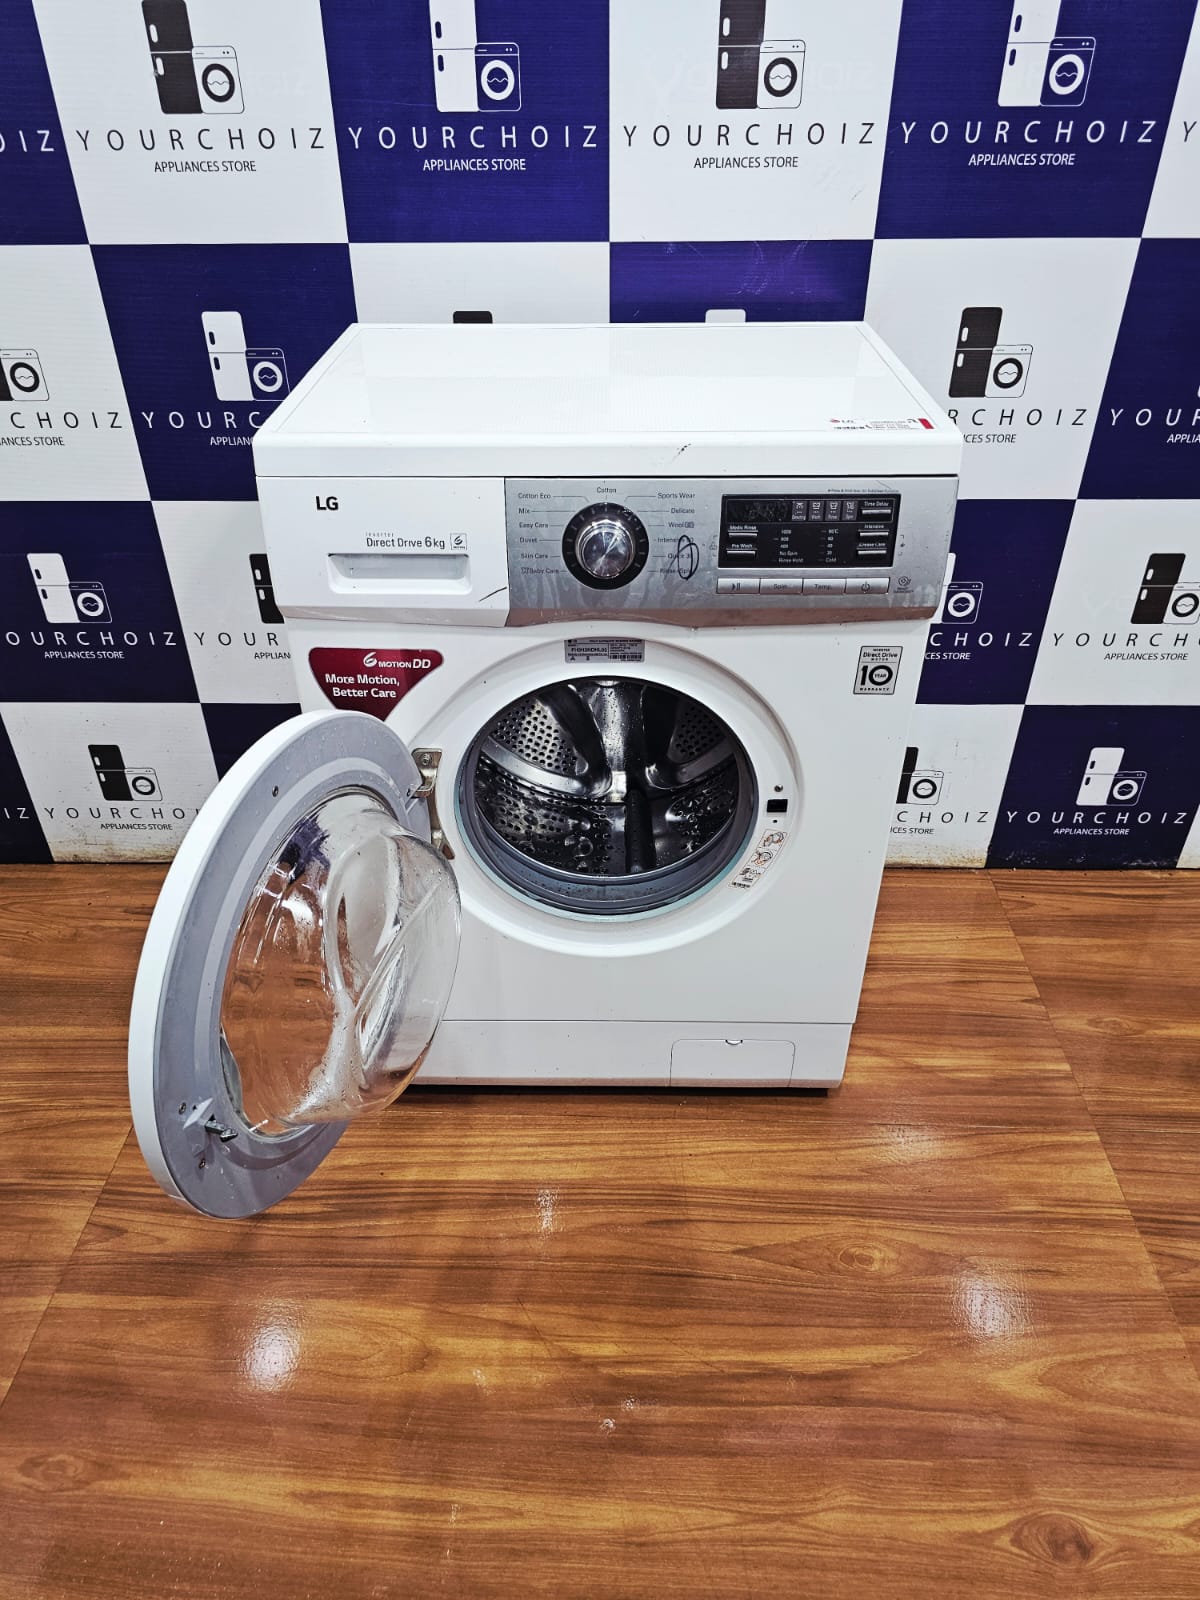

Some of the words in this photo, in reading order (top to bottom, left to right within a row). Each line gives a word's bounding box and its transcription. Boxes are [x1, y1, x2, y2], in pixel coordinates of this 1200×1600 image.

[348, 125, 597, 149] YOURCHOIZ
[623, 123, 875, 147] YOURCHOIZ
[901, 120, 1156, 144] YOURCHOIZ
[76, 127, 324, 151] YOURCHOIZ
[423, 159, 489, 171] APPLIANCES
[491, 158, 526, 170] STORE
[693, 157, 761, 169] APPLIANCES
[763, 156, 799, 168] STORE
[968, 153, 1037, 166] APPLIANCES
[1038, 153, 1076, 165] STORE
[154, 161, 220, 173] APPLIANCES
[221, 160, 257, 172] STORE
[10, 411, 122, 429] CHOIZ
[141, 411, 261, 429] YOURC
[948, 408, 1087, 426] RCHOIZ
[1, 436, 33, 446] ANCES
[34, 436, 65, 446] STORE
[210, 436, 251, 446] APPLIAN
[985, 434, 1017, 444] STORE
[1166, 433, 1200, 443] APPLIA
[316, 496, 339, 511] LG
[366, 537, 396, 547] Direct
[397, 537, 423, 548] Drive
[5, 631, 177, 646] OURCHOIZ
[930, 632, 1033, 646] CHOIZ
[1053, 632, 1189, 647] YOURCH
[44, 651, 96, 659] APPLIANCES
[97, 651, 125, 659] STORE
[942, 652, 971, 660] STORE
[1104, 652, 1158, 660] APPLIANCES
[1160, 652, 1188, 660] STORE
[325, 673, 354, 684] More
[357, 674, 400, 686] Motion,
[861, 665, 893, 686] 10
[332, 687, 368, 697] Better
[370, 688, 397, 698] Care
[43, 807, 198, 819] YOURCHO
[896, 810, 989, 824] CHOIZ
[1007, 810, 1187, 824] YOURCHOIZ
[147, 823, 173, 831] STORE
[1053, 827, 1103, 836] APPLIANCES
[1103, 828, 1130, 836] STORE
